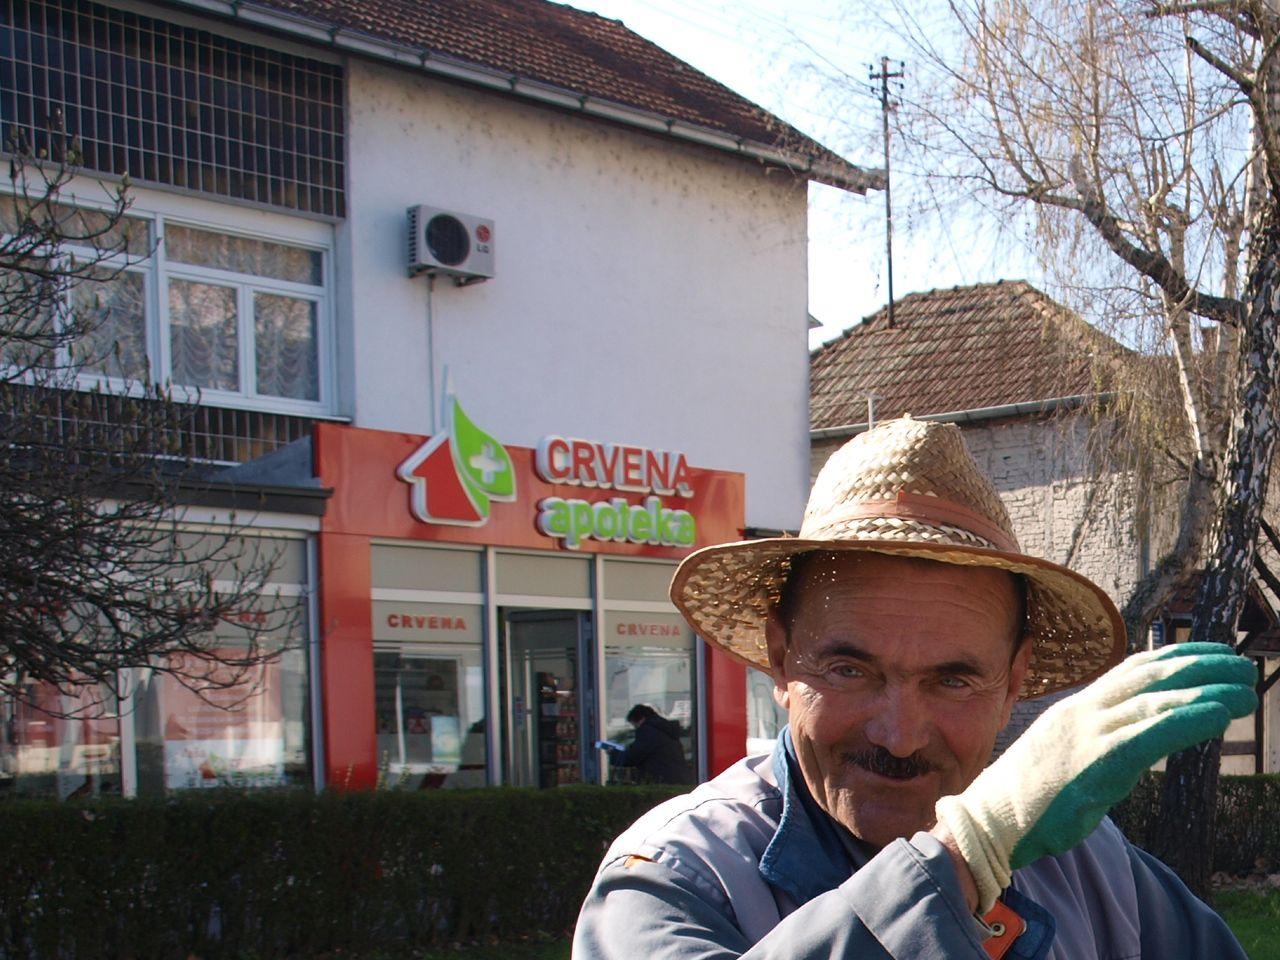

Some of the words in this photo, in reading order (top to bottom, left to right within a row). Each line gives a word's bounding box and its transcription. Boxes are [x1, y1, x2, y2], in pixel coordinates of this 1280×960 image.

[545, 437, 693, 494] CRVENA
[545, 497, 695, 548] apoteka
[387, 613, 467, 631] CRVENA
[616, 622, 681, 636] CRVENA
